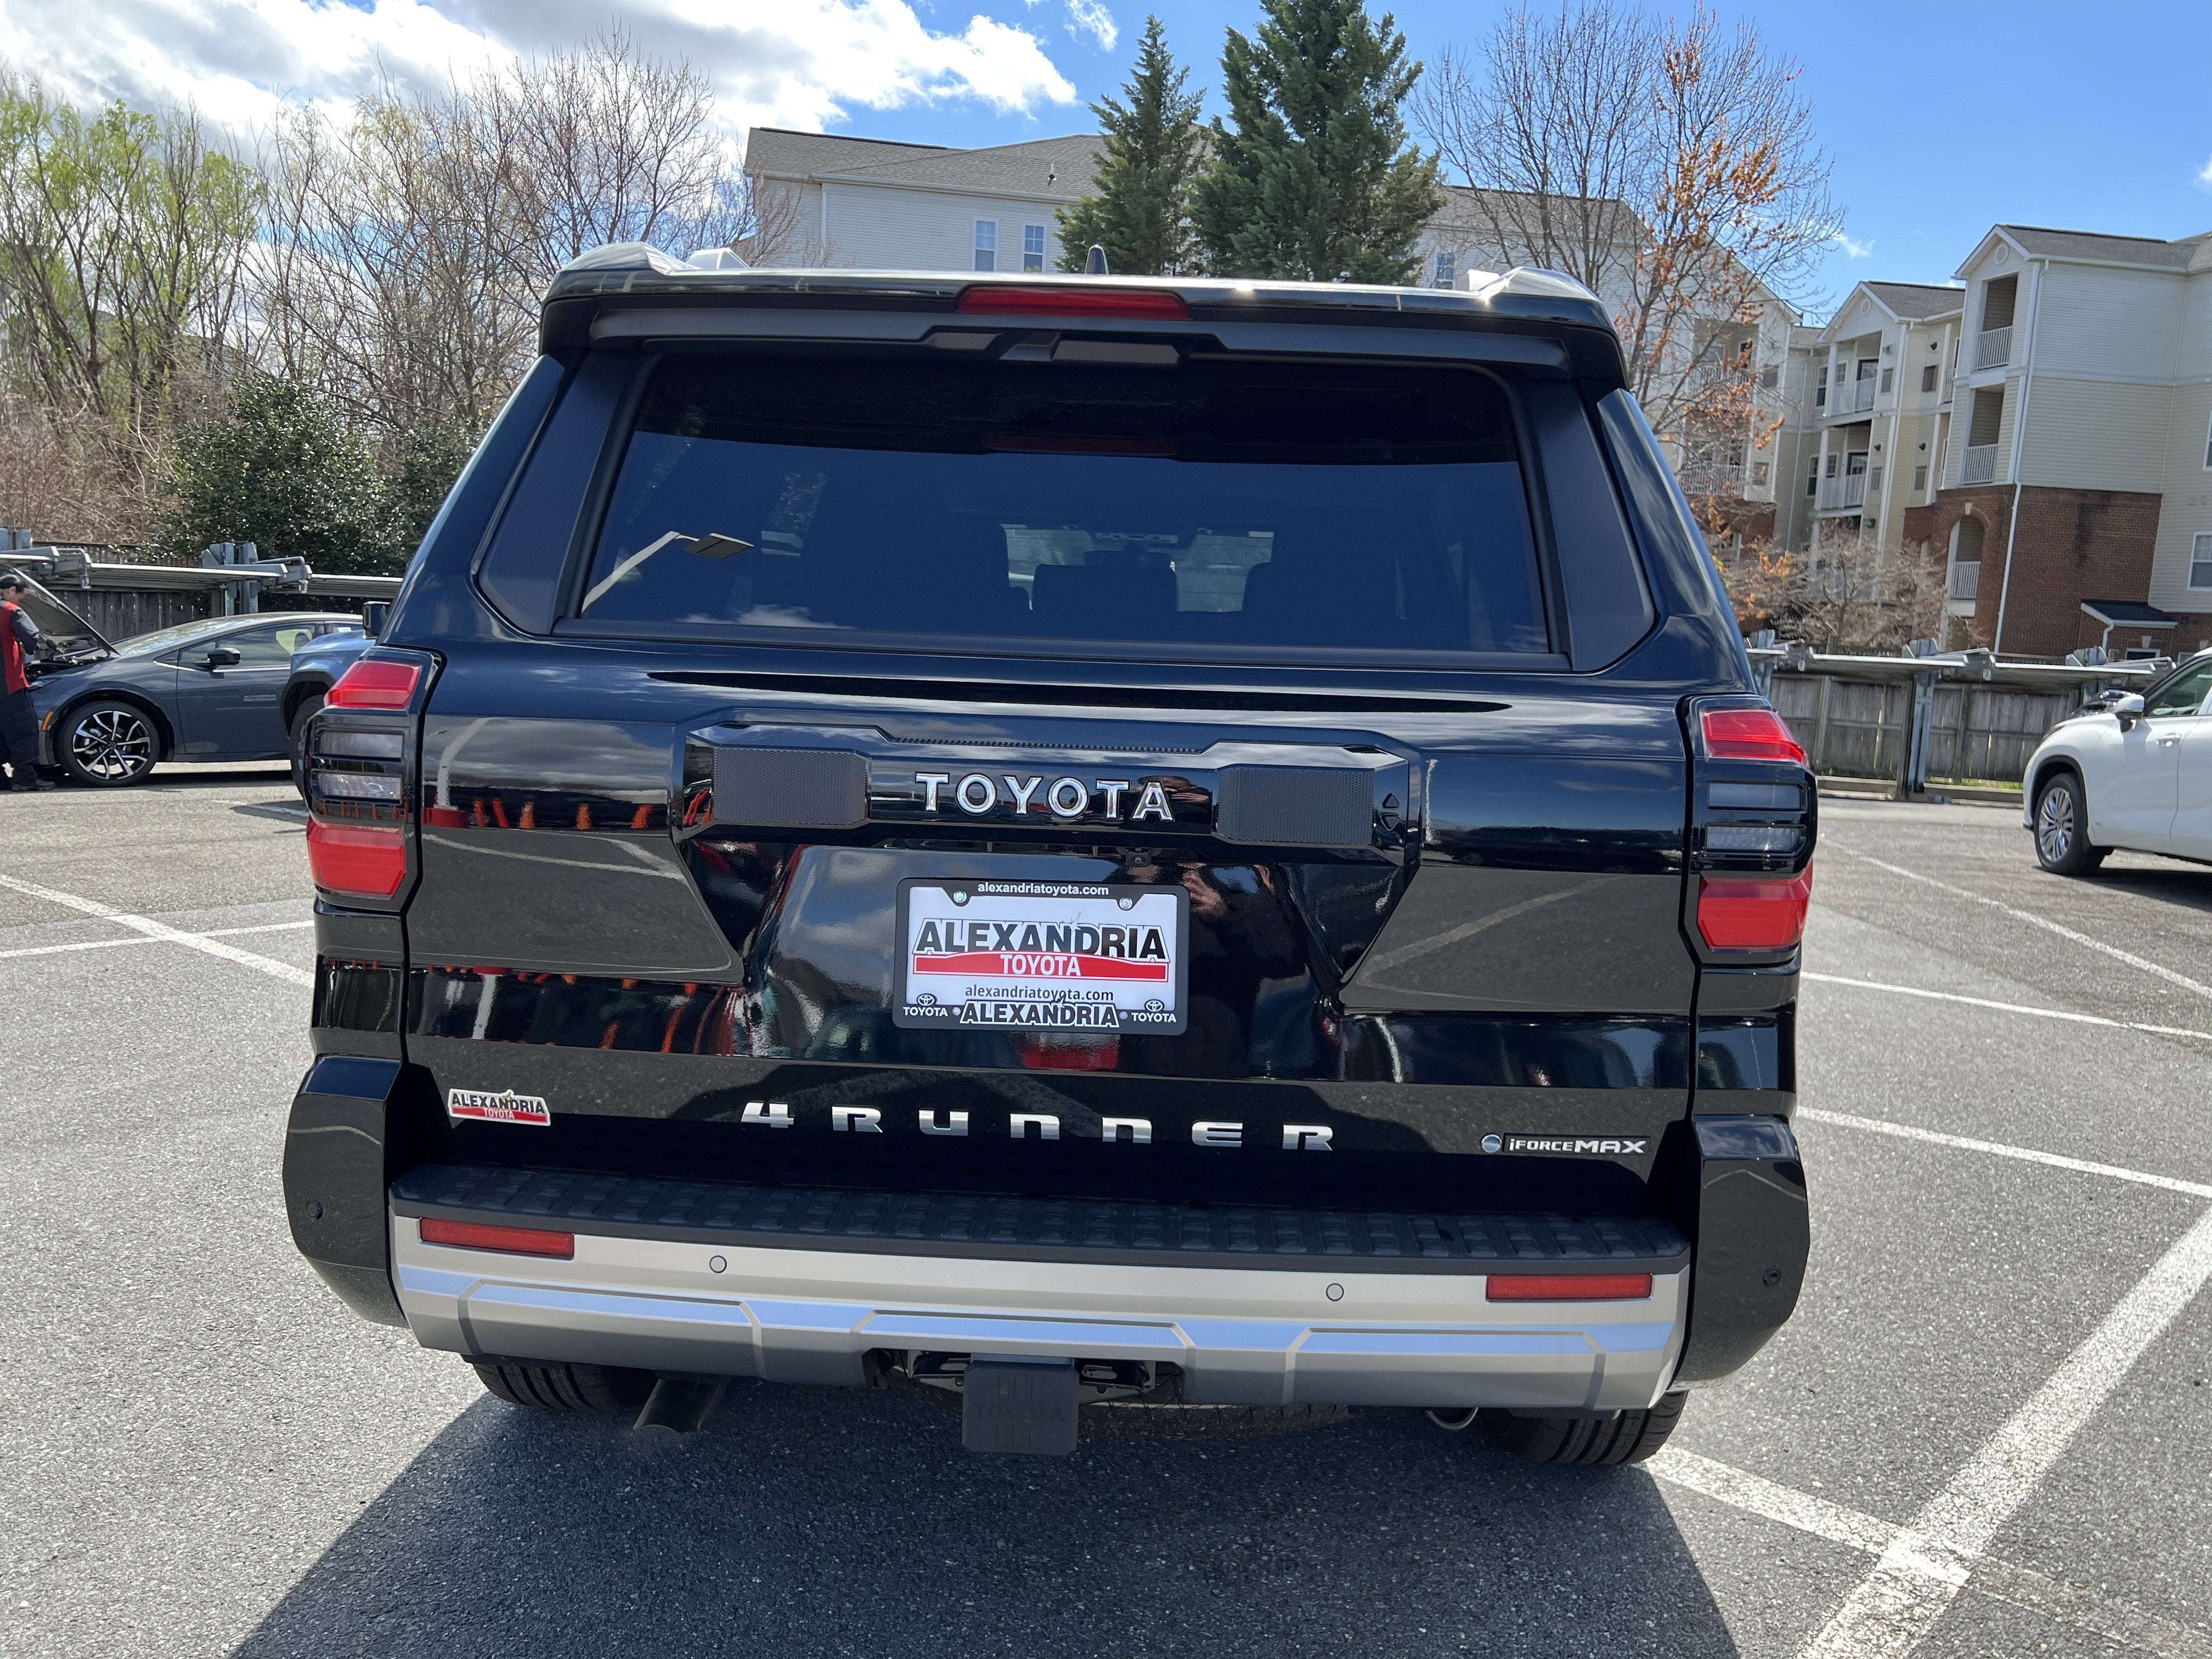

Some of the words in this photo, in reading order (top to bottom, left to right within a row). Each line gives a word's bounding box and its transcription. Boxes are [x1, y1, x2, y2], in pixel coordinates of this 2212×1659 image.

[916, 772, 1175, 822] TOYOTA
[977, 882, 1109, 896] alexandriatoyota.com
[915, 919, 1167, 961] ALEXANDRIA
[1000, 953, 1081, 977] TOYOTA
[965, 984, 1114, 1001] alexandriatoyota.com
[902, 1006, 948, 1017] TOYOTA
[960, 1000, 1119, 1028] ALEXANDRIA
[1131, 1012, 1177, 1023] TOYOTA
[452, 1093, 545, 1114] ALEXANDRIA
[483, 1108, 515, 1120] TOYOTA
[973, 1402, 1066, 1423] TOYOTA
